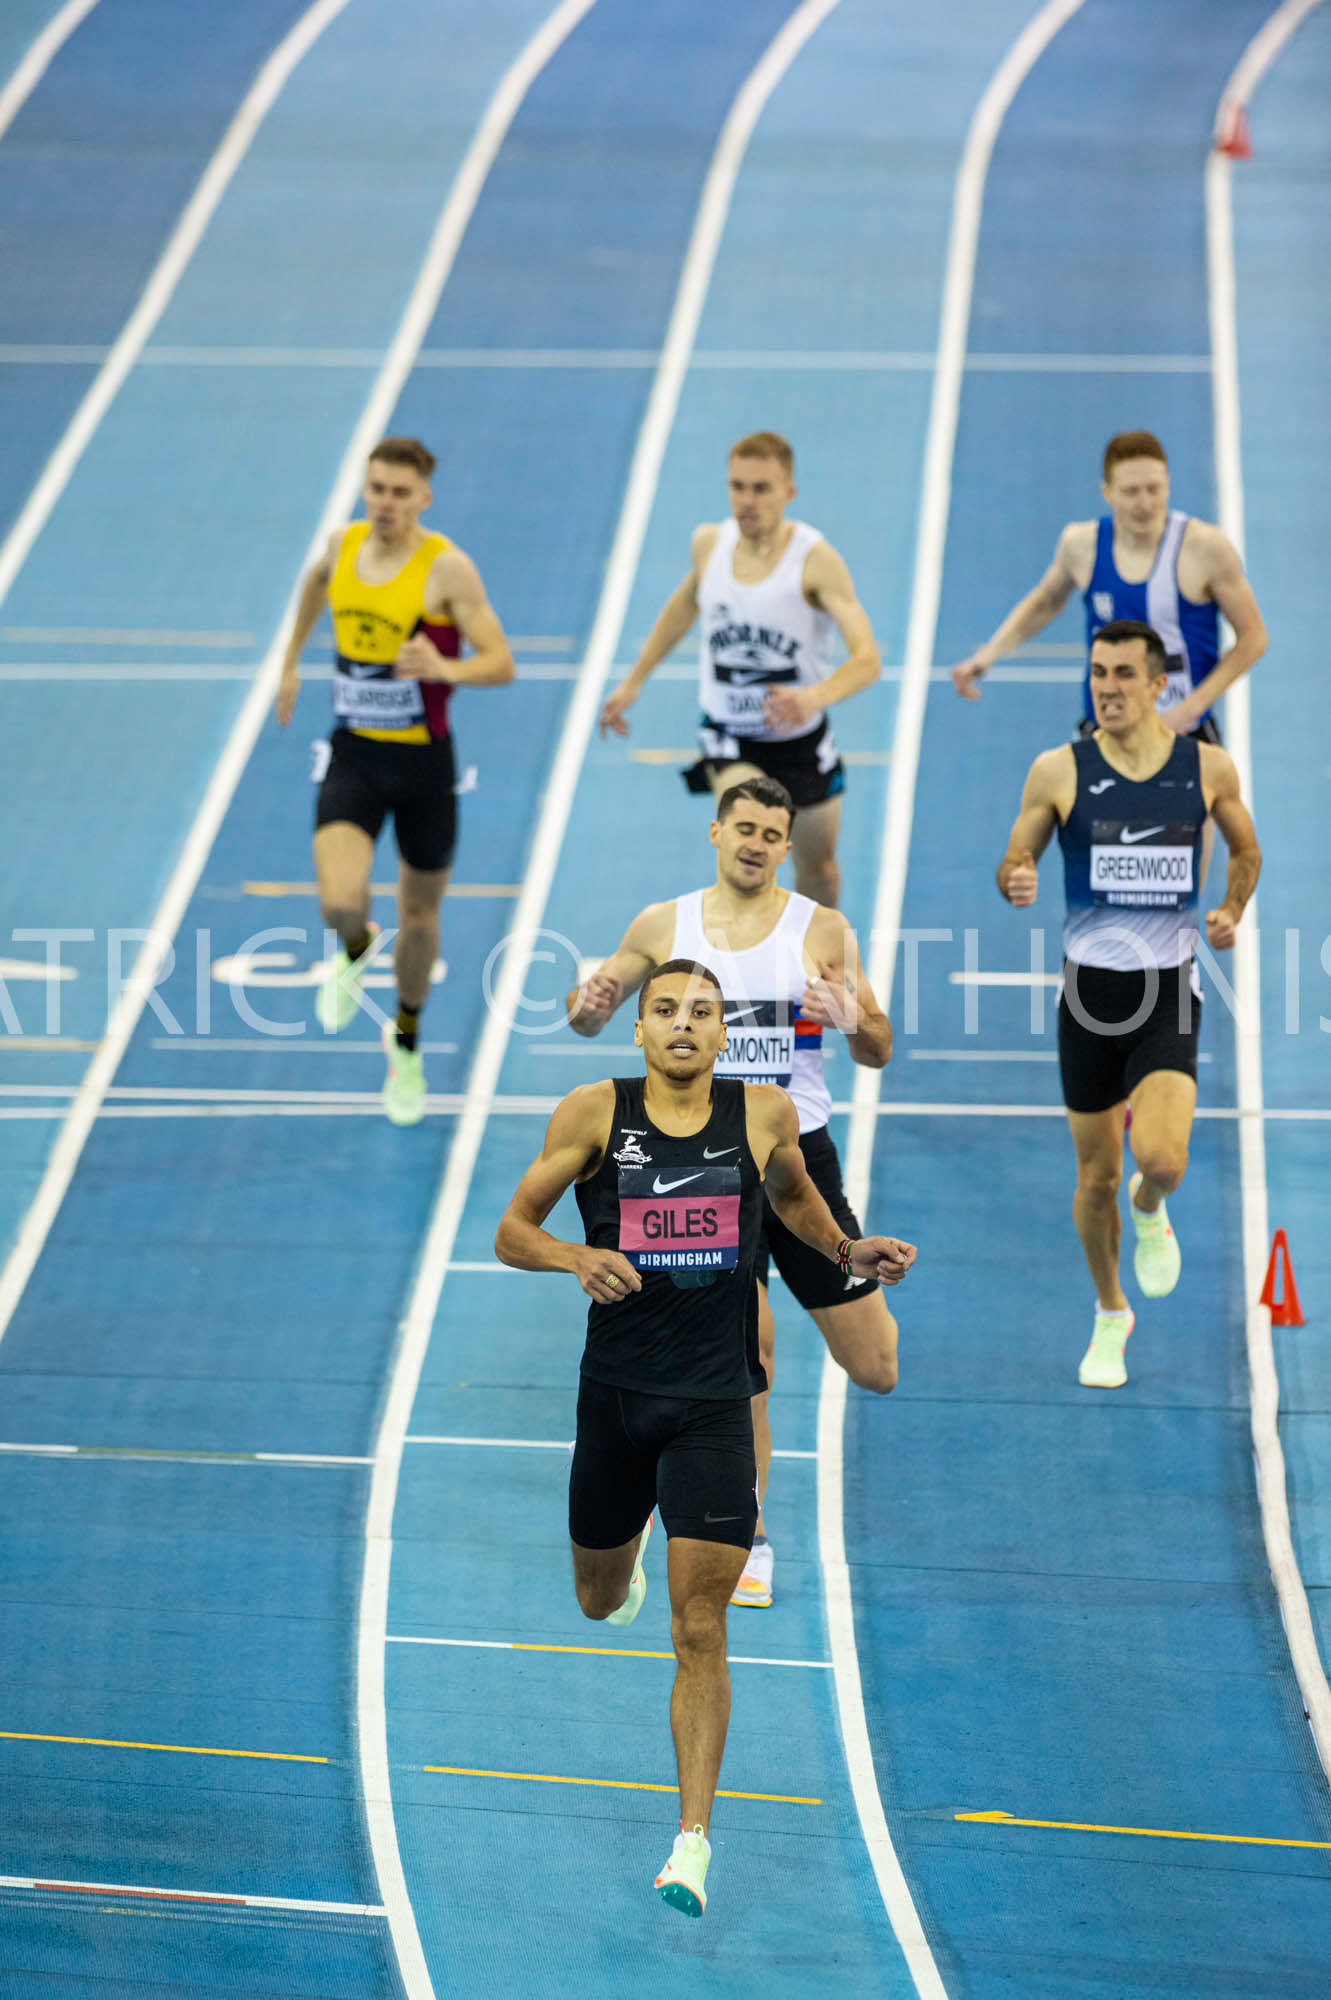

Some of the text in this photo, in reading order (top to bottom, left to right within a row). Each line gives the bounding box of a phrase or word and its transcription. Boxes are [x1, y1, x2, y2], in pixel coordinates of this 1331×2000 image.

[1097, 855, 1188, 881] GREENWOOD
[718, 1037, 790, 1063] RMONTH
[642, 1208, 718, 1239] GILES
[639, 1251, 722, 1266] BIRMINGHAM
